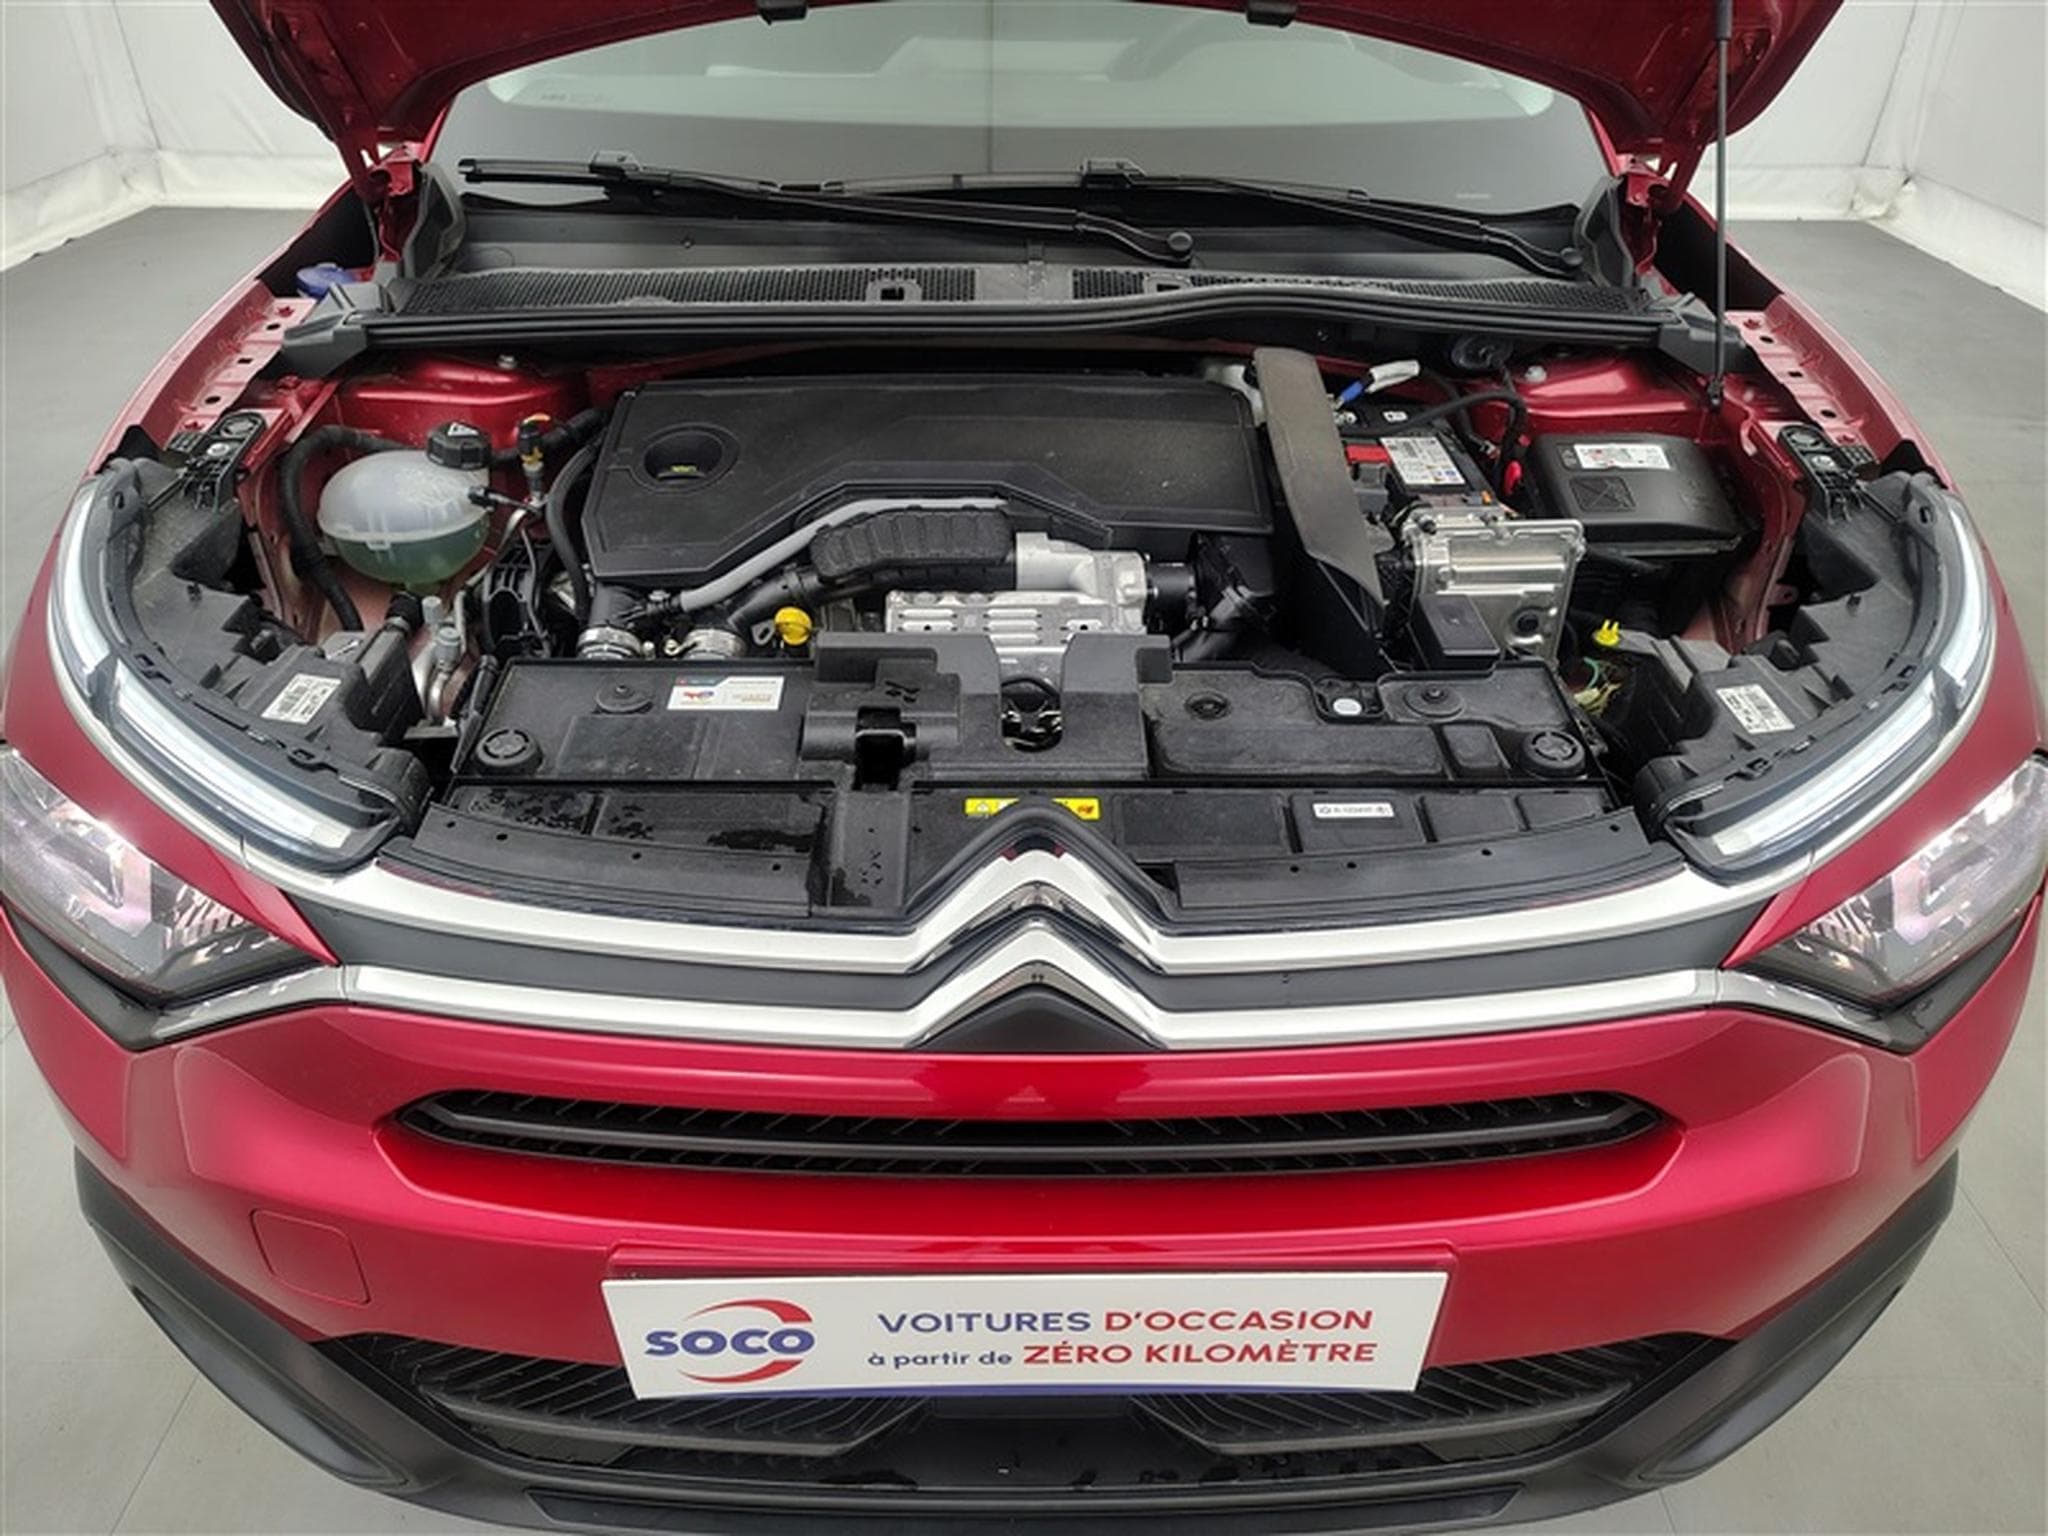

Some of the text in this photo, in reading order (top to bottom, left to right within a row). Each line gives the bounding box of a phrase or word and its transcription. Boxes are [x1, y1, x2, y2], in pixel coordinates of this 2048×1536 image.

[878, 1310, 1373, 1333] VOITURES D'OCCASION
[644, 1329, 815, 1356] SOCO
[867, 1339, 1378, 1369] à partir de ZÉRO KILOMÈTRE
